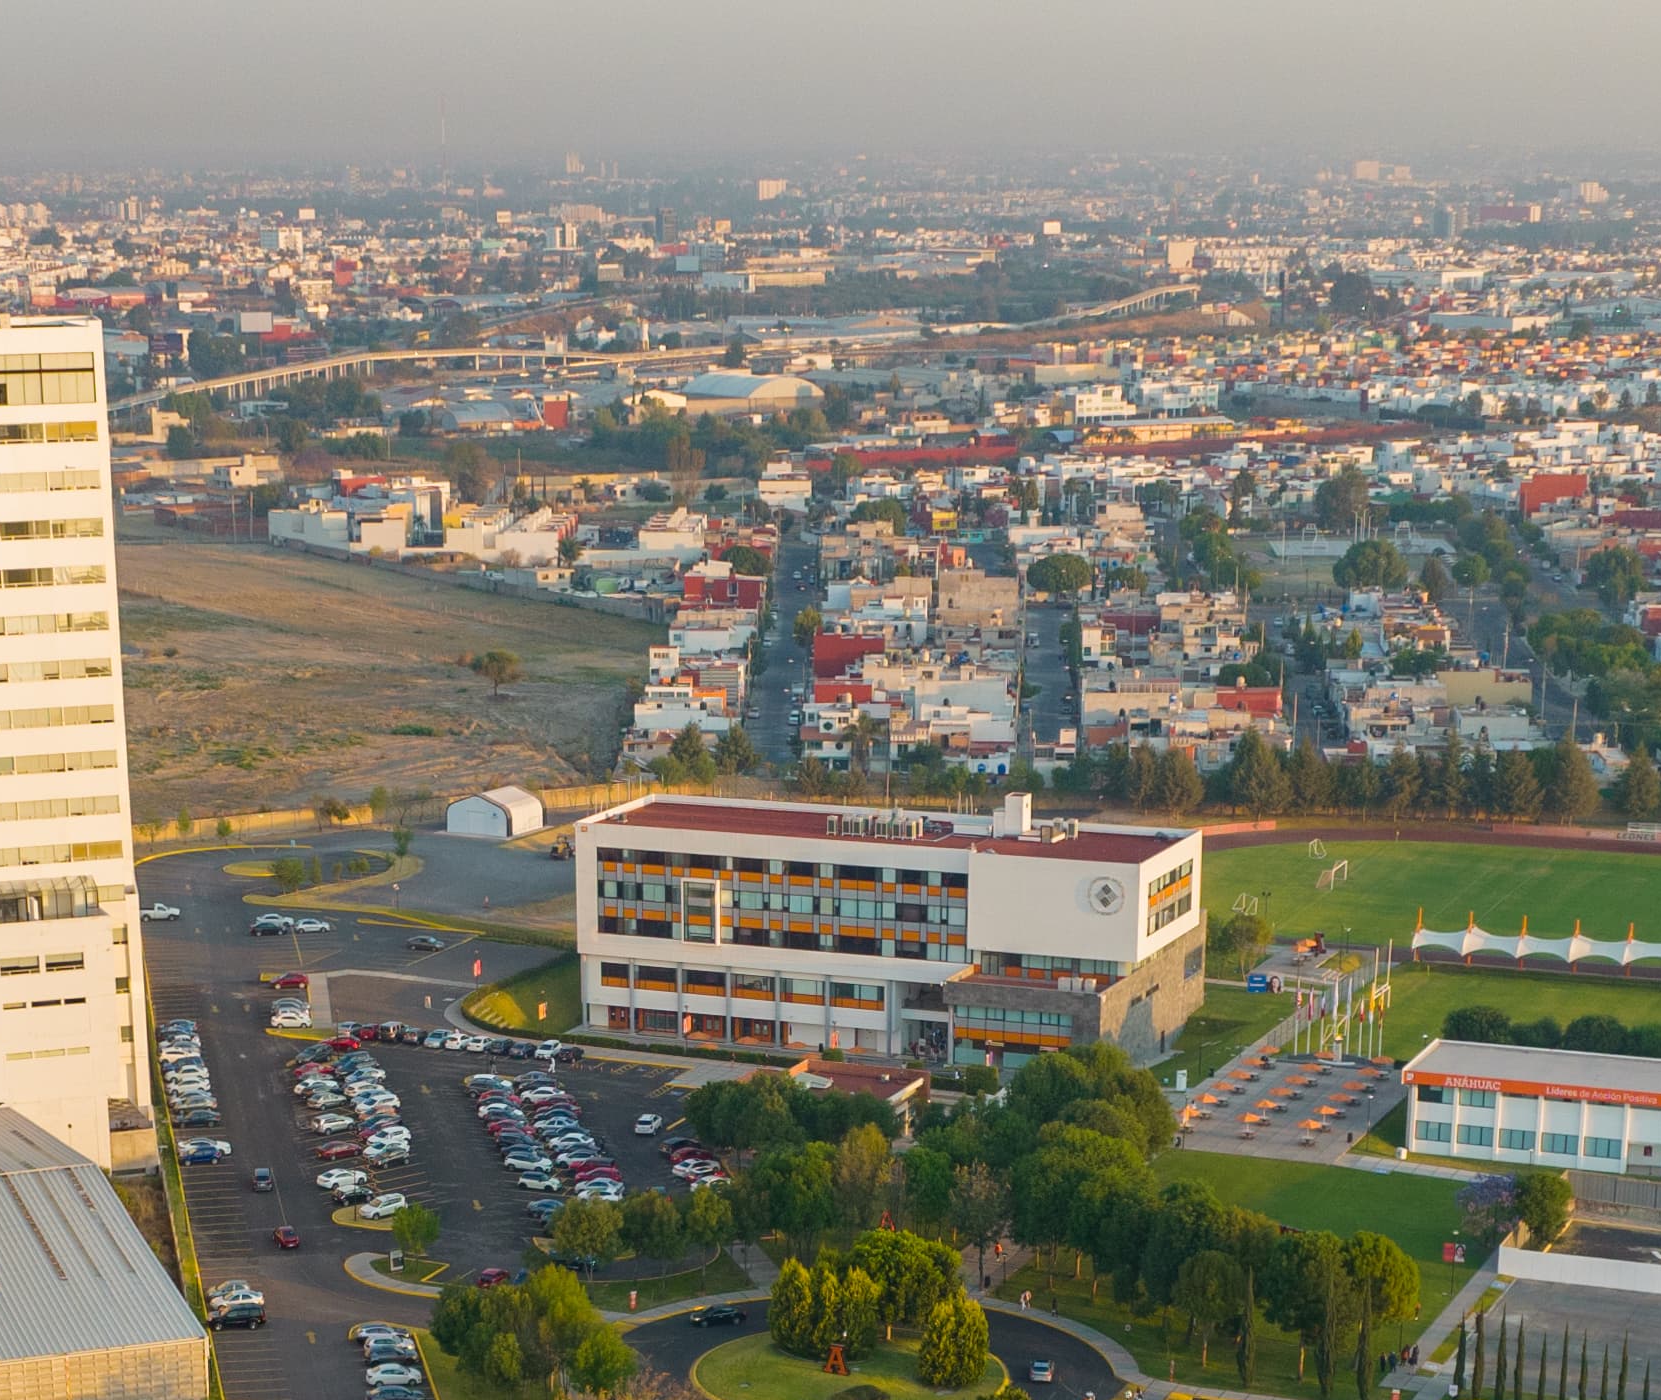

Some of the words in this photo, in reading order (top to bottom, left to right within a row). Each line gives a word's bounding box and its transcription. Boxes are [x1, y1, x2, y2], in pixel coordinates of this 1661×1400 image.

[1444, 1075, 1501, 1091] ANÁHUAC
[1545, 1086, 1577, 1098] Líderes
[1591, 1089, 1621, 1102] Acción
[1622, 1093, 1658, 1105] Positiva
[823, 1344, 850, 1376] A
